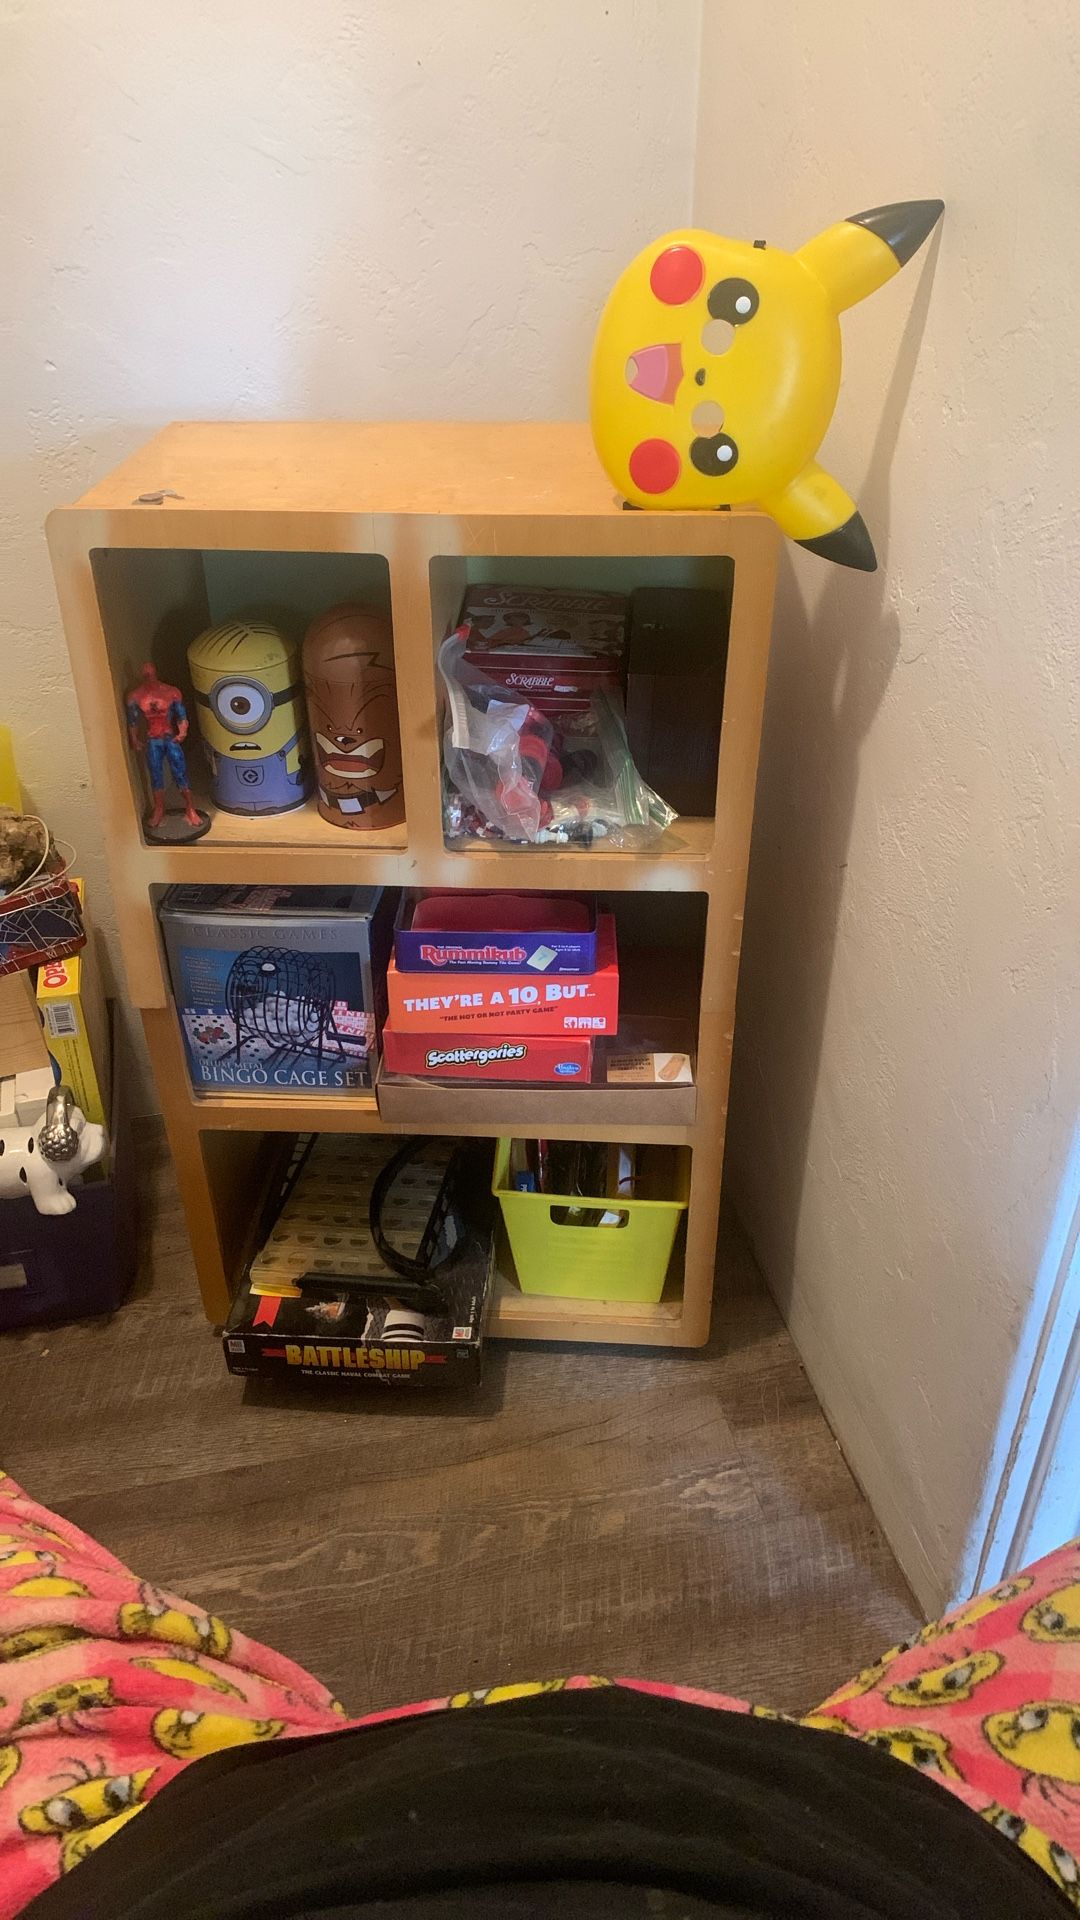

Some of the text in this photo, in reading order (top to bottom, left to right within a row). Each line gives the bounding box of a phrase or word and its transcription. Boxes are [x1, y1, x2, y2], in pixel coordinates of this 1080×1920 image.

[273, 927, 338, 940] GAMES
[420, 945, 527, 966] Rummikub
[403, 992, 483, 1012] THEY'RE
[490, 991, 505, 1004] A
[426, 1043, 527, 1068] Scattergories
[201, 1065, 368, 1087] BINGO CAGE SET
[285, 1344, 426, 1370] BATTLESHIP
